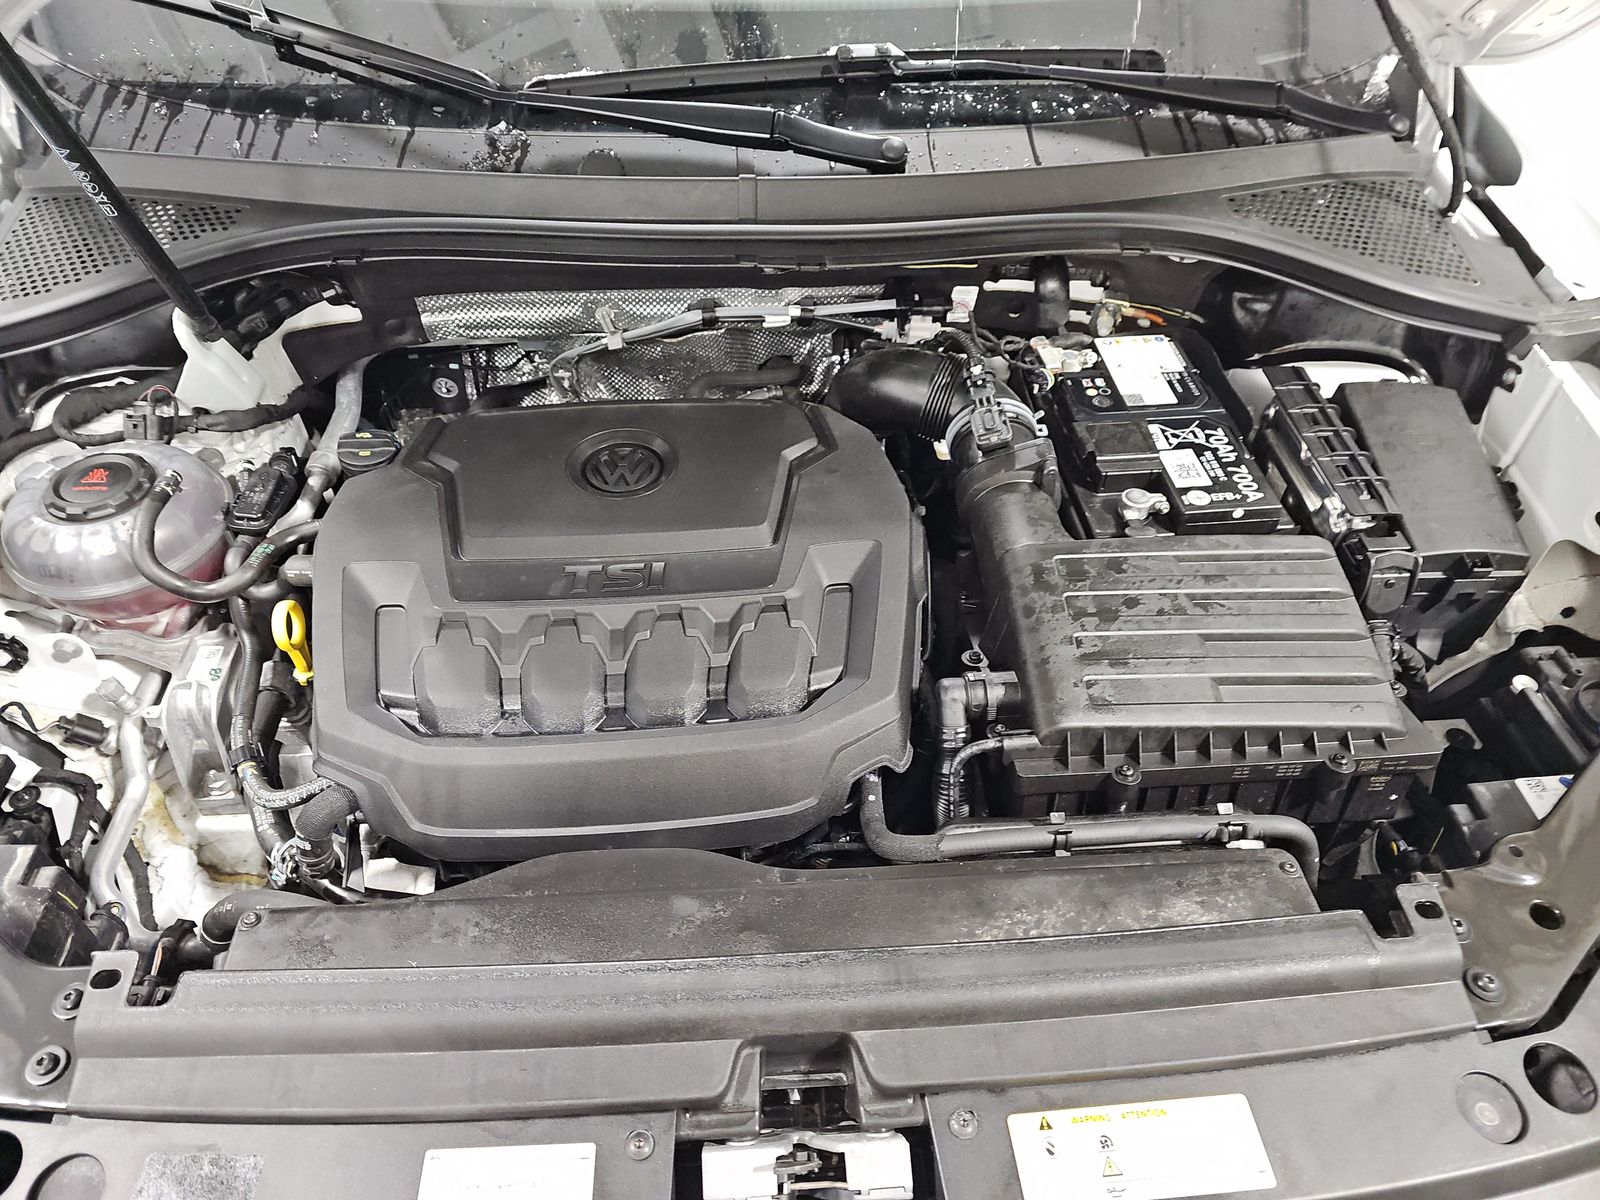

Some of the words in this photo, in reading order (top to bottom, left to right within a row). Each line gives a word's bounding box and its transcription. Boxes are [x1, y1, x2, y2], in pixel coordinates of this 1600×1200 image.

[1204, 427, 1239, 463] 70Ah
[1227, 464, 1265, 502] 700A
[562, 561, 667, 593] TSI
[1070, 1114, 1112, 1124] WARNING
[1121, 1109, 1167, 1119] ATTENTION
